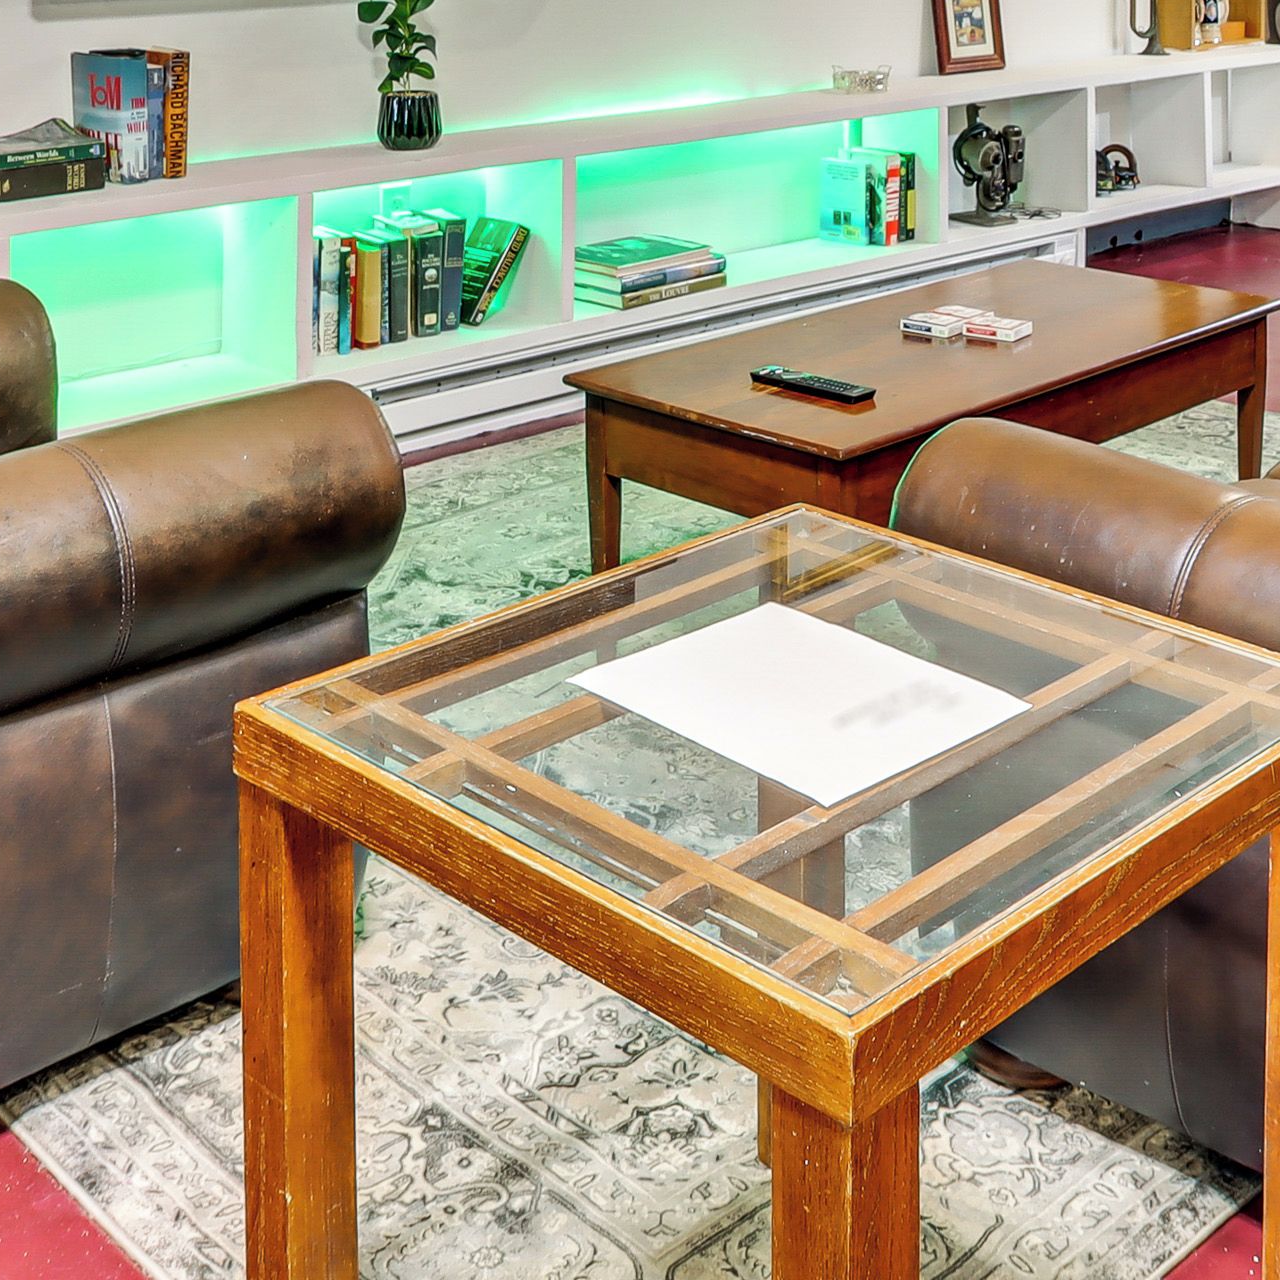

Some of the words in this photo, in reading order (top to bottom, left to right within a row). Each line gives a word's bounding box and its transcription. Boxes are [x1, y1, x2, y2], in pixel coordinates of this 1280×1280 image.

[88, 74, 121, 110] TOM
[170, 52, 185, 109] RICHARD
[130, 96, 145, 109] TOM
[6, 154, 35, 163] Between
[35, 149, 59, 158] Worlds
[169, 113, 184, 177] BACHMAN
